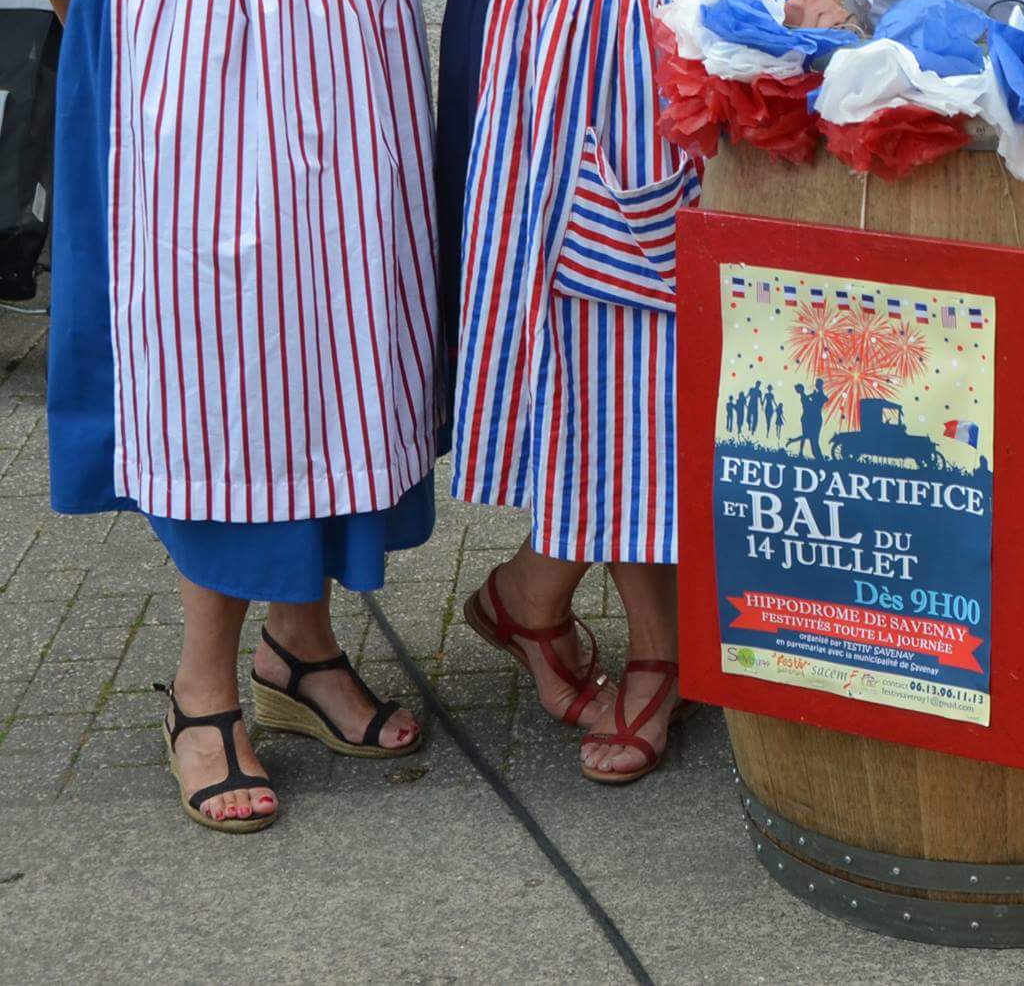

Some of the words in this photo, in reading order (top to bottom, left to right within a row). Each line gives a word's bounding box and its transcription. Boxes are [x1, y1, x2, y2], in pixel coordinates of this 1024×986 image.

[719, 456, 786, 490] FEU
[793, 466, 985, 516] D'ARTIFICE
[723, 501, 748, 517] ET
[746, 489, 863, 545] BAL
[874, 529, 912, 552] DU
[746, 534, 775, 560] 14
[781, 537, 918, 580] JUILLET
[745, 594, 860, 623] HIPPODROME
[864, 611, 887, 628] DE
[890, 616, 967, 643] SAVENAY
[853, 579, 904, 611] Dès
[910, 588, 981, 625] 9H00
[761, 611, 831, 632] FESTIVITÉS
[833, 623, 876, 641] TOUTE
[878, 631, 894, 644] LA
[896, 634, 953, 654] JOURNÉE
[776, 638, 785, 646] en
[786, 640, 827, 654] partenariat
[828, 648, 845, 658] avec
[845, 650, 853, 660] la
[853, 652, 898, 667] municipalité
[899, 659, 909, 670] de
[799, 633, 829, 646] organisé
[830, 639, 842, 648] par
[873, 646, 915, 661] SAVENAY
[811, 665, 848, 681] sacem
[882, 679, 909, 692] contact
